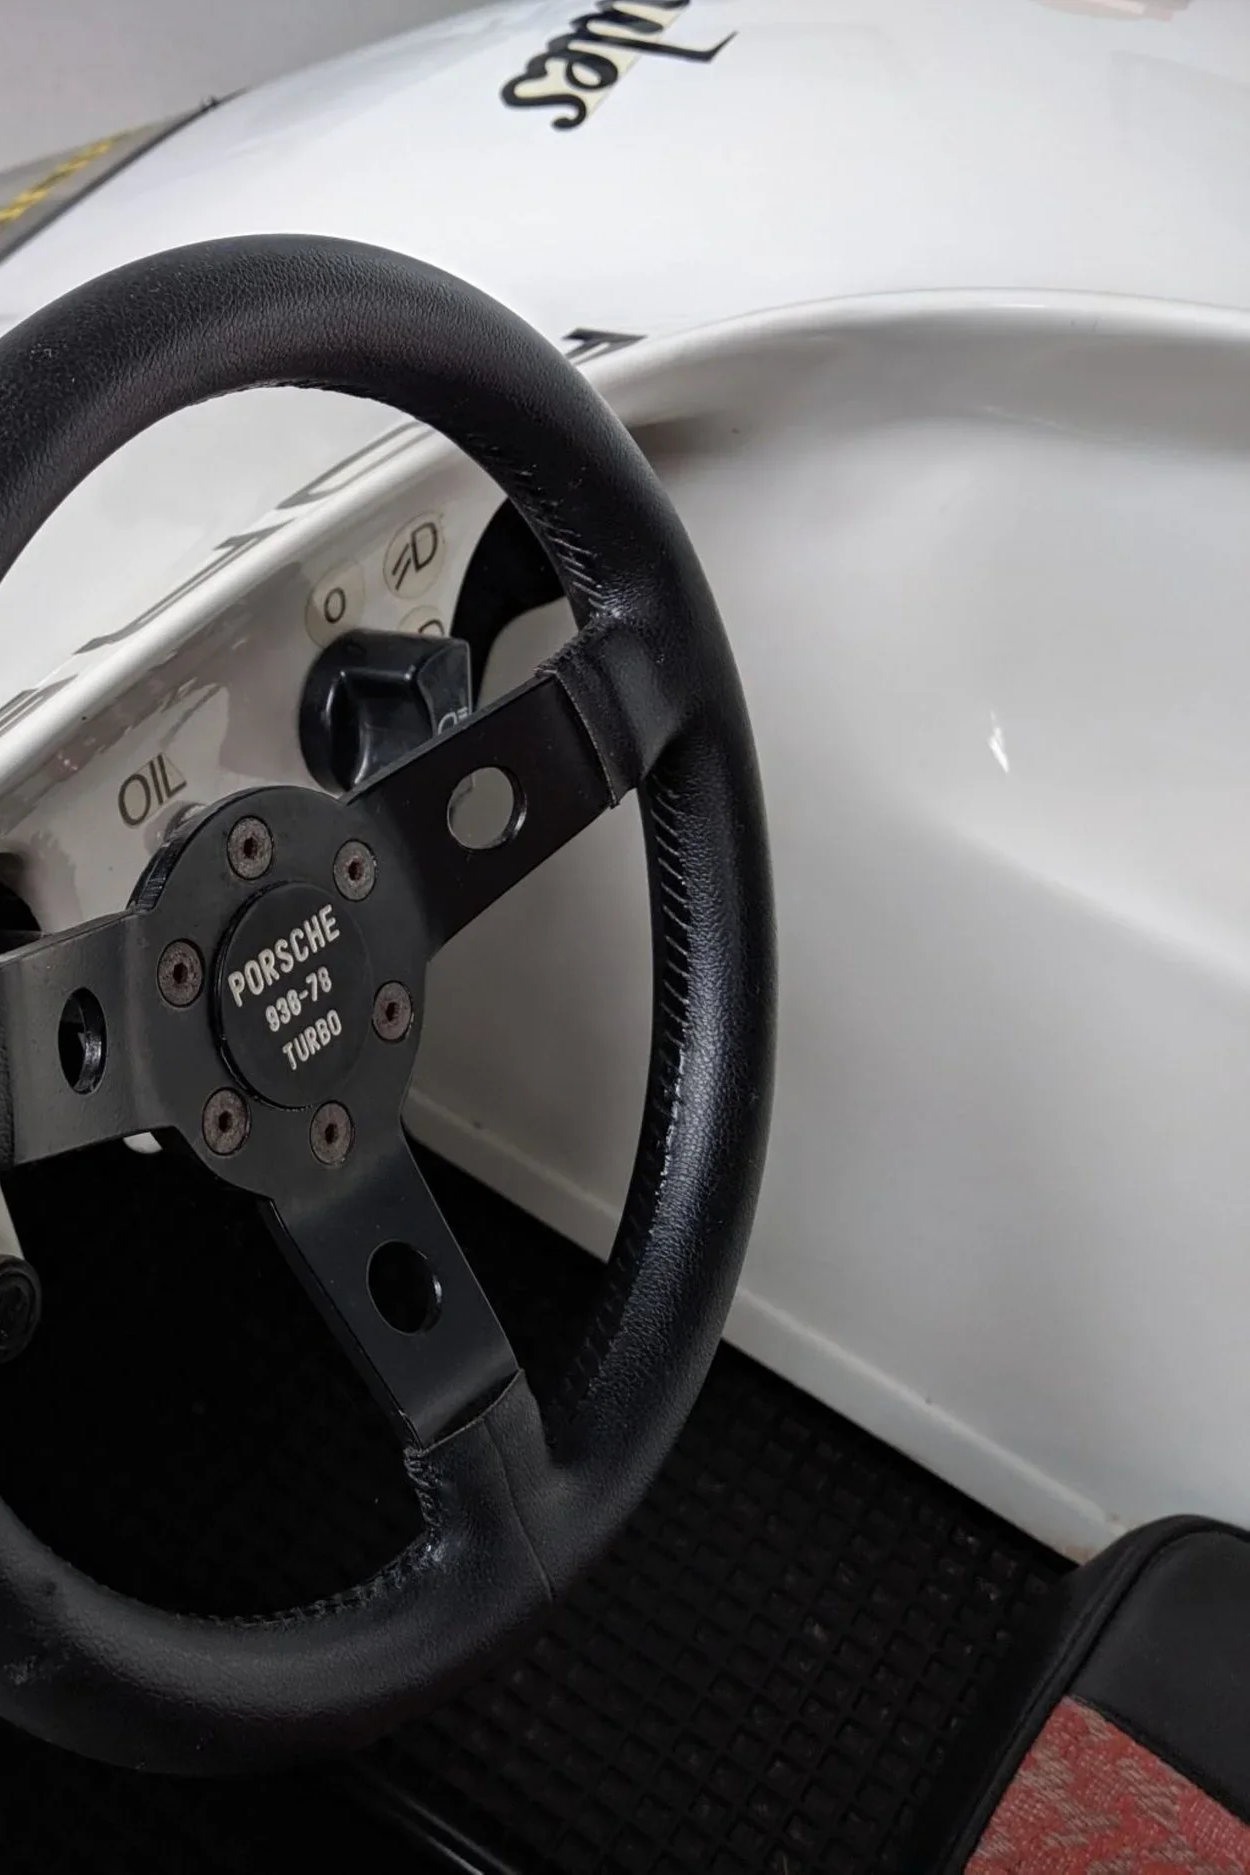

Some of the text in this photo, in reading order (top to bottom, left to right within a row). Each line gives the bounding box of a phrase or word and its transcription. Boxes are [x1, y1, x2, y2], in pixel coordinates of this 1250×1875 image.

[118, 753, 187, 827] OIL
[228, 904, 340, 1008] PORSCHE
[282, 1009, 342, 1071] TURBO
